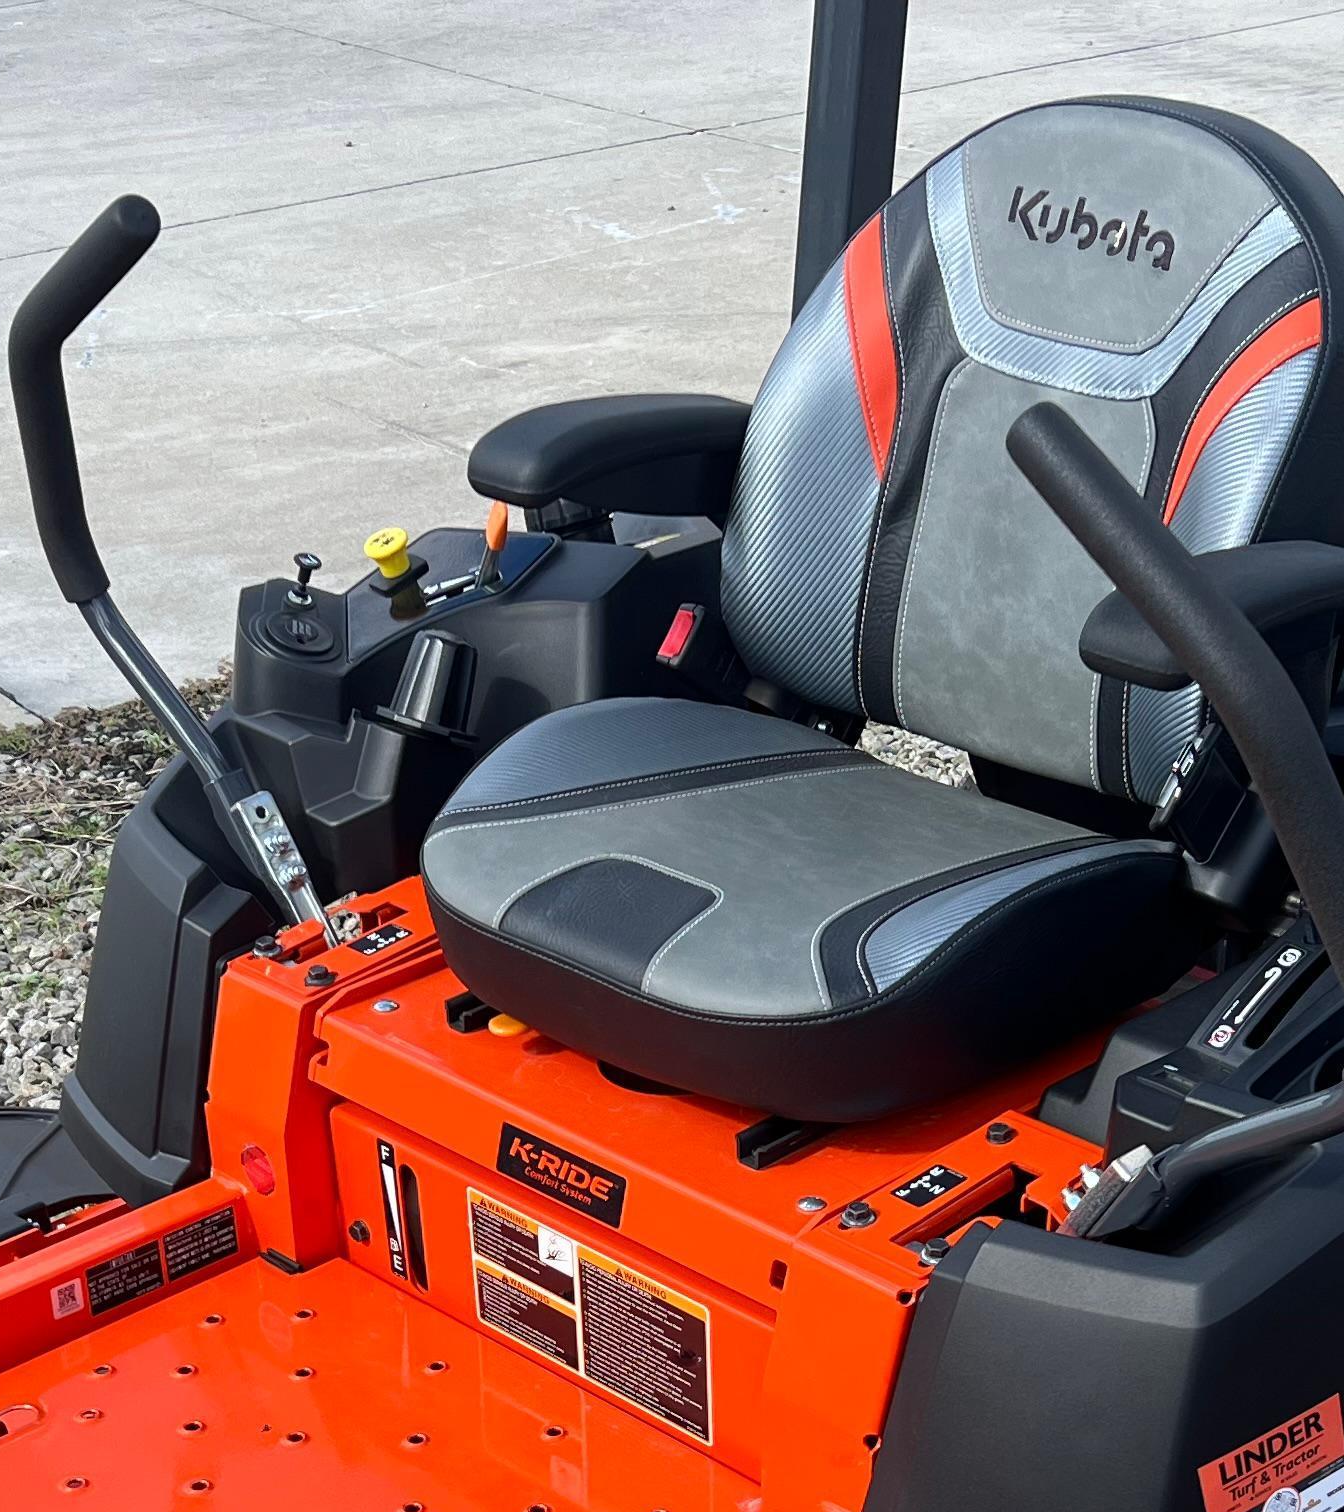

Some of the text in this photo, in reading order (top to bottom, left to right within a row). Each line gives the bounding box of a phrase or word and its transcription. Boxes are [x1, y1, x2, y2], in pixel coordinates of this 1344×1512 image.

[1007, 184, 1176, 272] Kubota
[380, 1144, 390, 1160] F
[509, 1137, 614, 1202] K-RIDE
[524, 1166, 593, 1206] Comfort System
[487, 1198, 529, 1229] WARNING
[393, 1254, 404, 1272] E
[623, 1270, 668, 1300] WARNING
[1218, 1410, 1324, 1486] LINDER
[1229, 1476, 1258, 1502] Turf
[1260, 1470, 1272, 1486] &
[1273, 1443, 1321, 1478] Tractor
